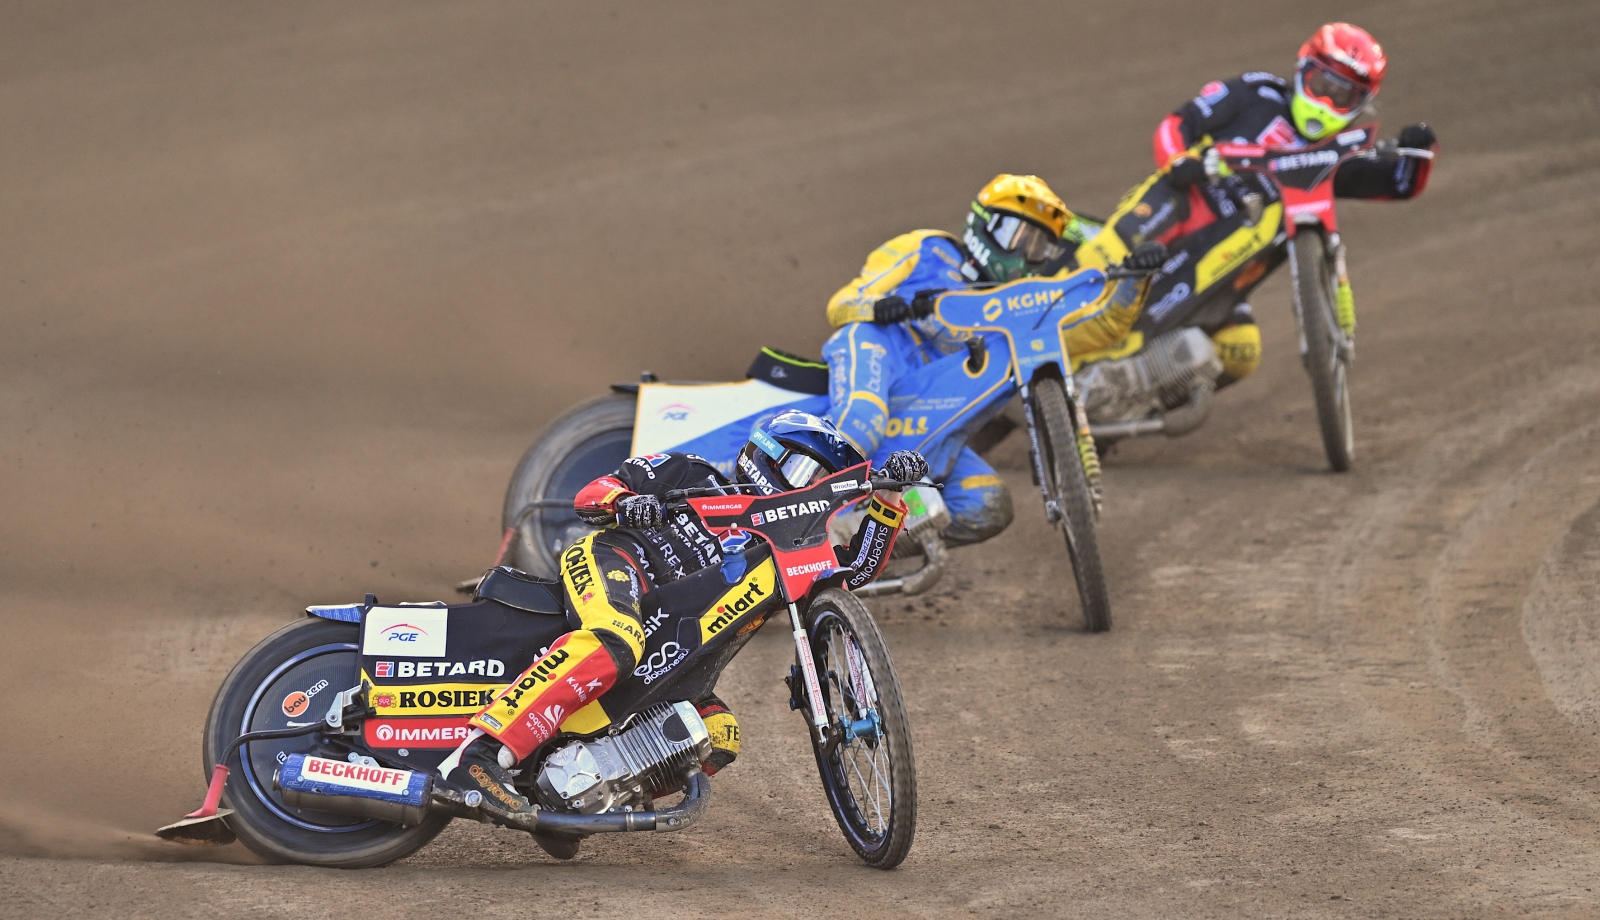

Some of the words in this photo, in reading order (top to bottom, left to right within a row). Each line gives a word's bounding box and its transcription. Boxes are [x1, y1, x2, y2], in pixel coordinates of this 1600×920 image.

[1007, 288, 1065, 311] KGHM
[741, 456, 781, 496] BETARD
[707, 503, 742, 511] IMMERGAS
[765, 499, 831, 524] BETARD
[850, 525, 888, 586] superpolisa
[786, 560, 832, 577] BECKHOFF
[707, 581, 765, 635] milart
[388, 632, 419, 642] PGE
[397, 659, 505, 678] BETARD
[500, 648, 569, 708] milart
[399, 689, 496, 708] ROSIEK
[307, 758, 405, 787] BECKHOFF
[469, 764, 523, 811] daytona
